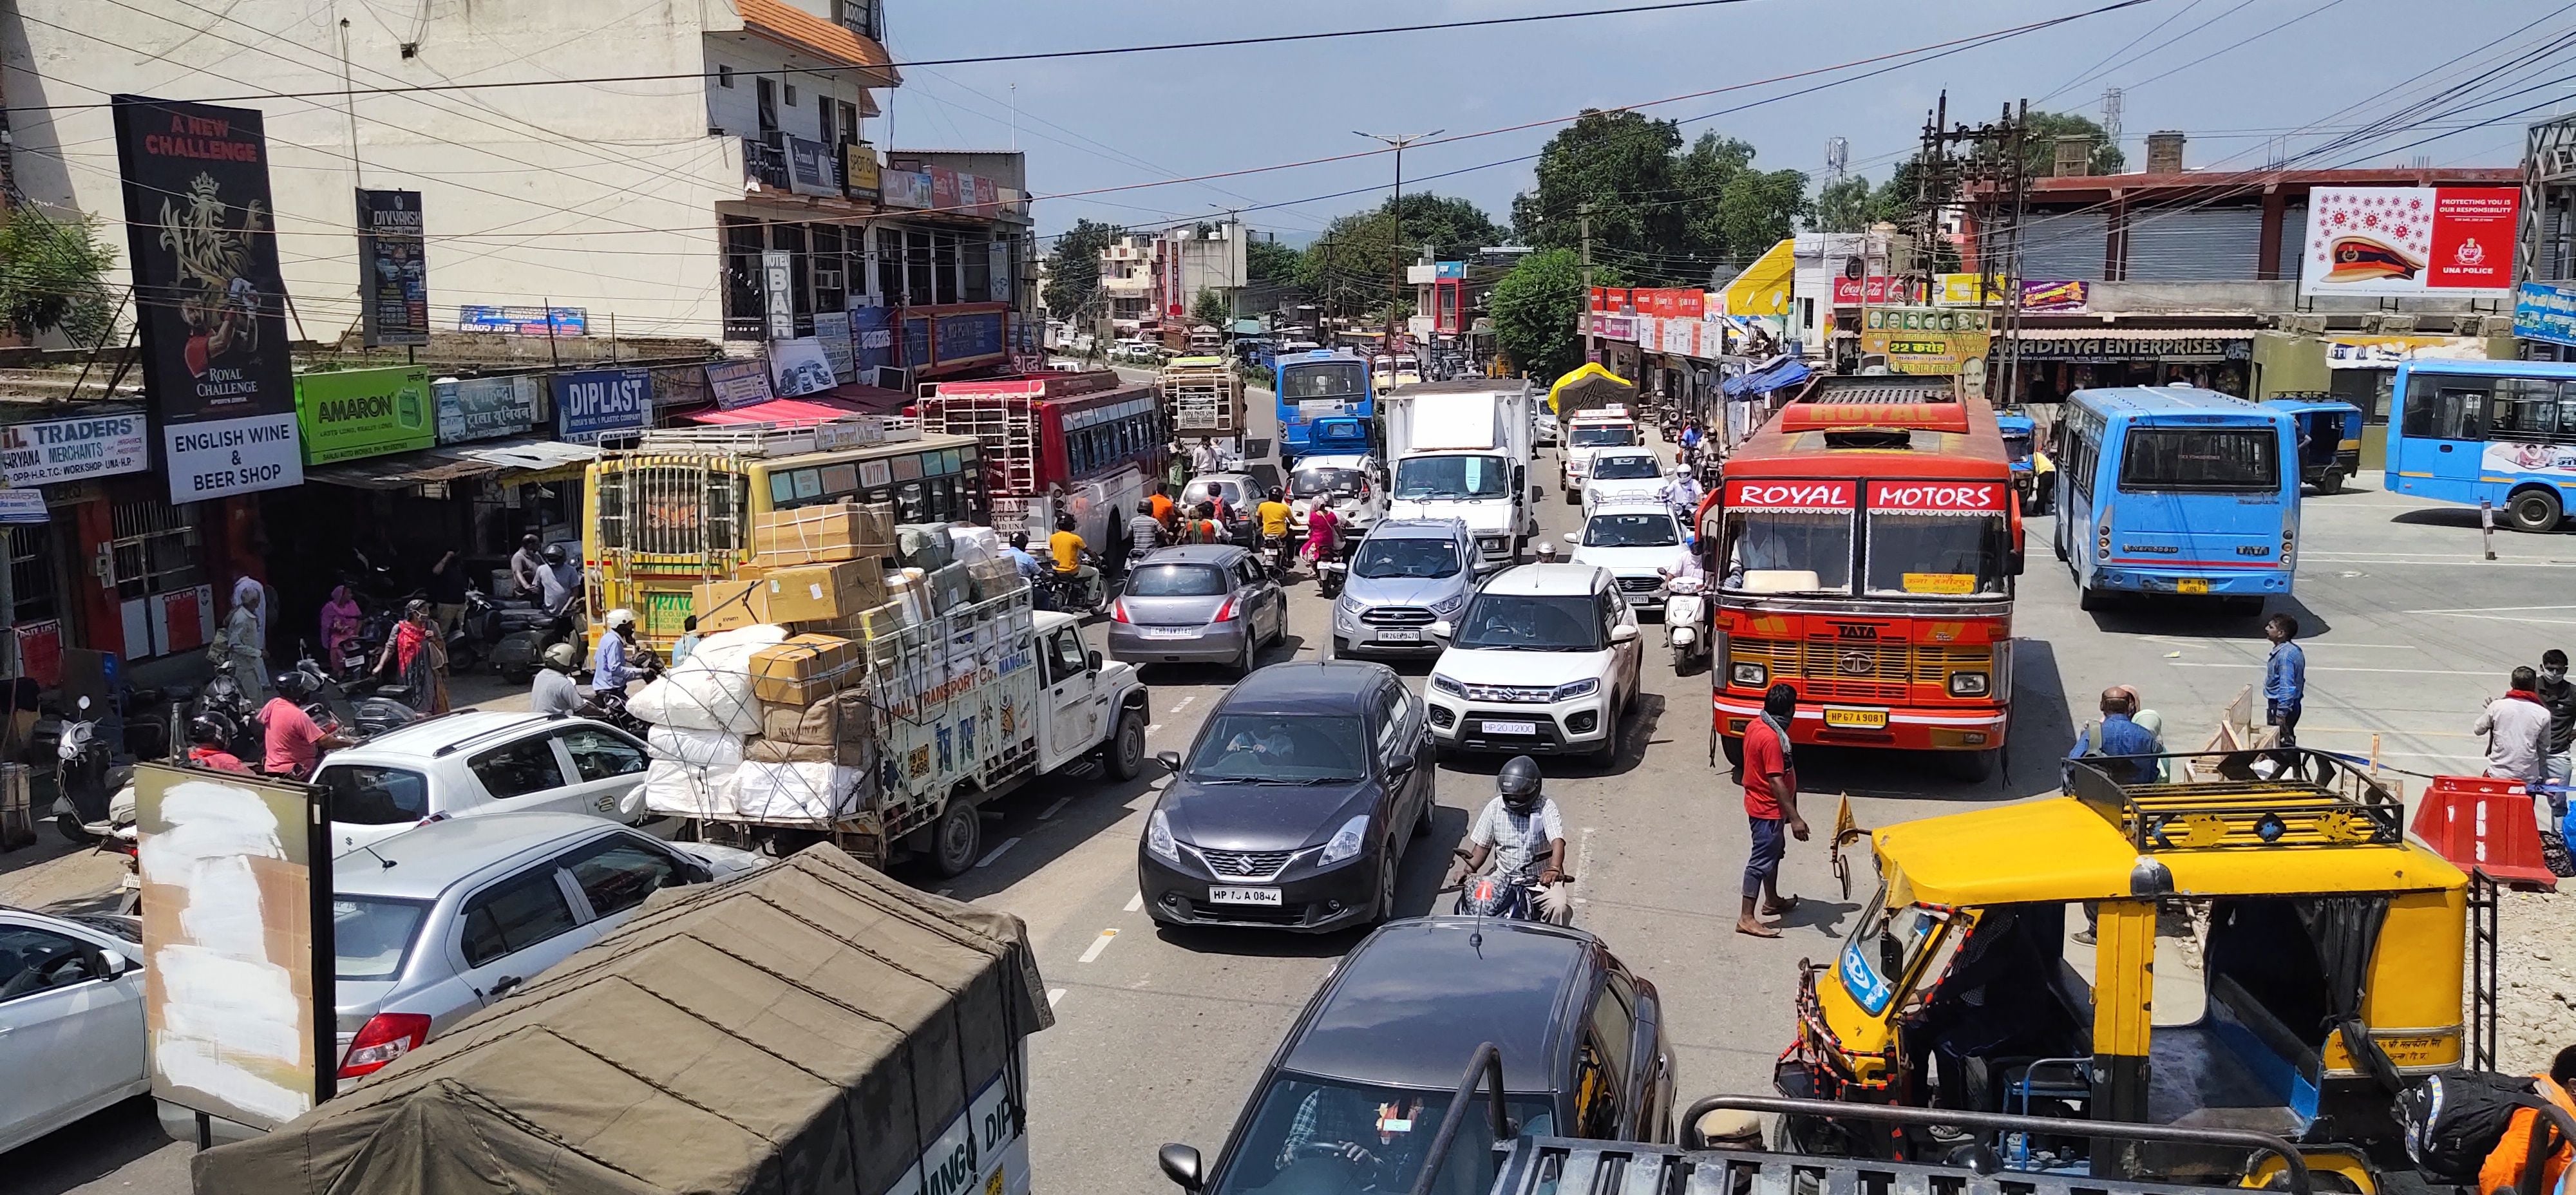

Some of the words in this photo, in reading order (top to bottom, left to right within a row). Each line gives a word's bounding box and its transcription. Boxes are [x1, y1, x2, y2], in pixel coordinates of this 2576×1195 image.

[171, 115, 184, 133] A
[188, 117, 229, 137] NEW
[145, 134, 256, 162] CHALLENGE
[374, 211, 422, 225] DIVYANSH
[768, 269, 790, 338] BAR
[461, 323, 491, 332] COVER
[495, 324, 516, 332] SEAT
[1890, 343, 1909, 352] 22
[1912, 343, 1944, 354] करोड़
[2105, 339, 2222, 355] ENTERPRISES
[209, 368, 243, 383] ROYAL
[196, 381, 258, 397] CHALLENGE
[569, 379, 642, 417] DIPLAST
[319, 393, 392, 424] AMARON
[1810, 405, 1938, 422] ROYAL
[601, 415, 620, 424] PLASTIC
[33, 419, 133, 445] TRADERS
[175, 429, 244, 453] ENGLISH
[248, 424, 290, 444] WINE
[578, 433, 594, 442] R.K
[48, 442, 104, 464] MERCHANTS
[232, 450, 242, 466] &
[64, 460, 102, 476] WORKSHOP
[194, 471, 236, 491] BEER
[240, 464, 281, 484] SHOP
[1739, 485, 1847, 505] ROYAL
[1879, 486, 1992, 507] MOTORS
[2237, 546, 2268, 555] TATA
[1838, 625, 1878, 637] TATA
[878, 699, 915, 724] KMAL
[918, 669, 978, 707] RANSPORT
[980, 666, 997, 685] Co.
[999, 650, 1032, 675] NANGAL
[1844, 713, 1853, 721] 67
[1862, 713, 1883, 722] 9081
[1214, 890, 1227, 899] HP
[1244, 891, 1251, 900] A
